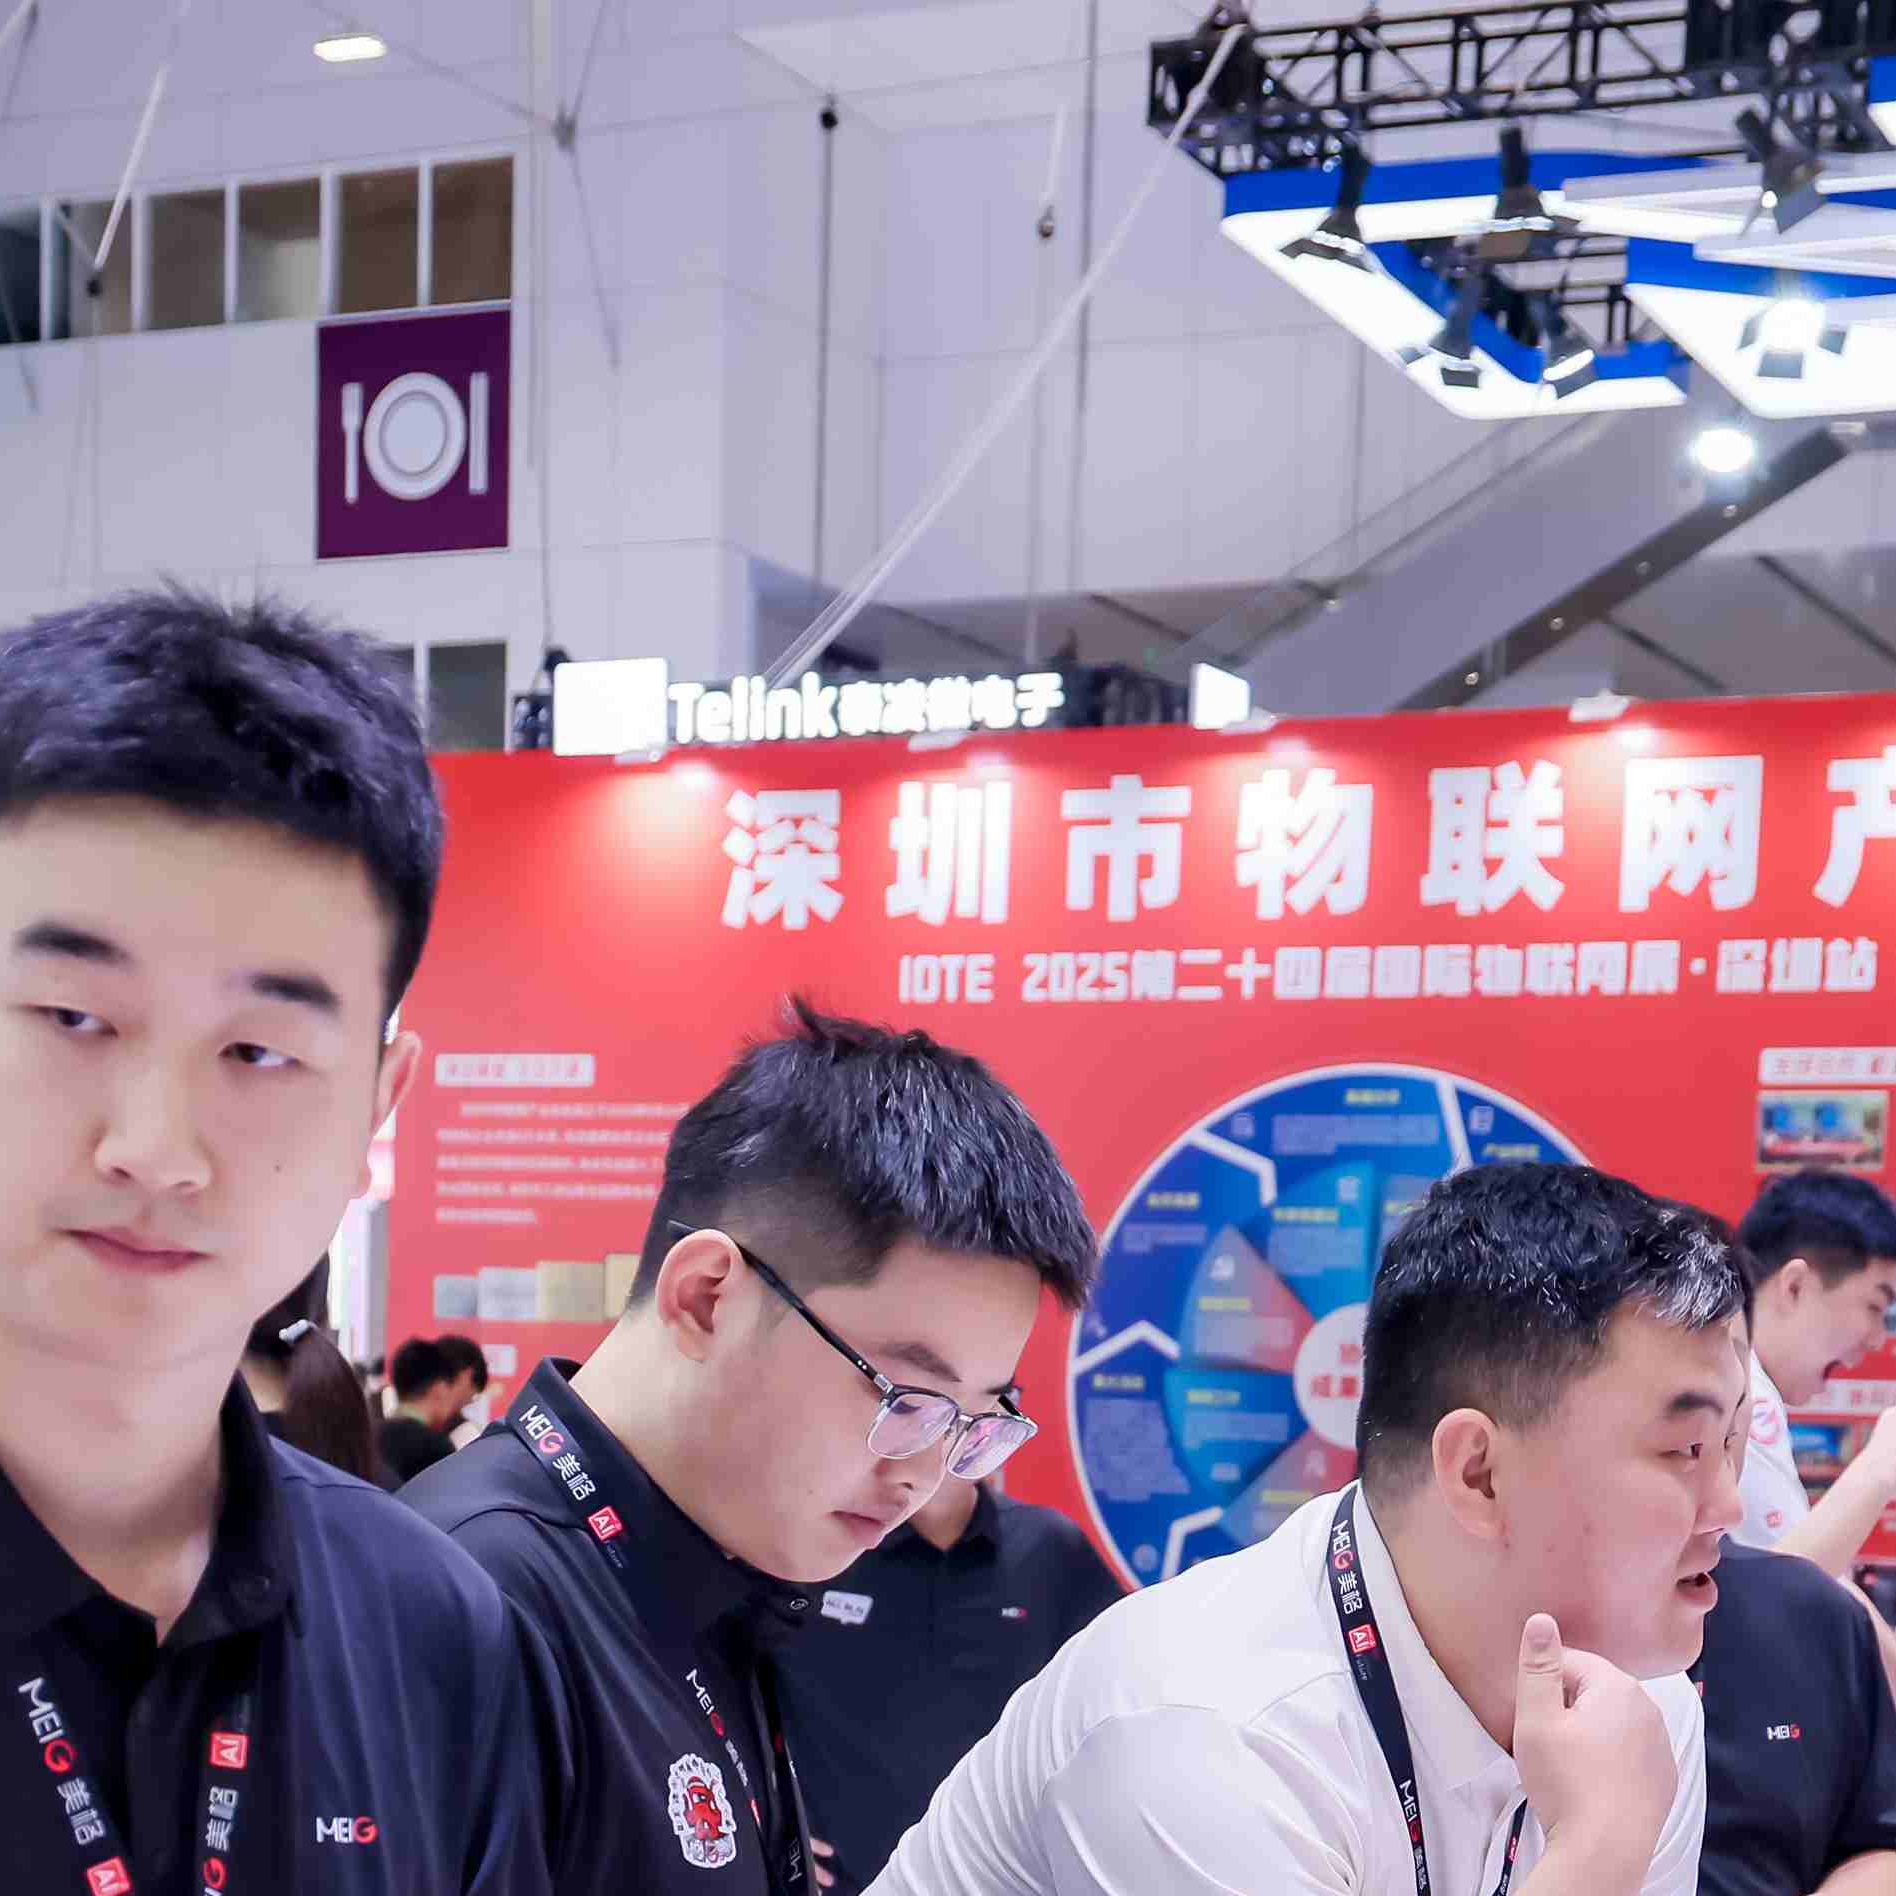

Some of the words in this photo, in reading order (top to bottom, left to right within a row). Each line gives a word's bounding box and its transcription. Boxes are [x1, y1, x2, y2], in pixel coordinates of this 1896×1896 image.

[668, 671, 839, 743] Telink
[898, 953, 996, 1004] IOTE
[519, 1405, 564, 1454] MEIG
[553, 1453, 596, 1501] 美格
[1333, 1519, 1355, 1570] MEIG
[18, 1677, 77, 1773] MEIG
[316, 1816, 379, 1845] MEIG
